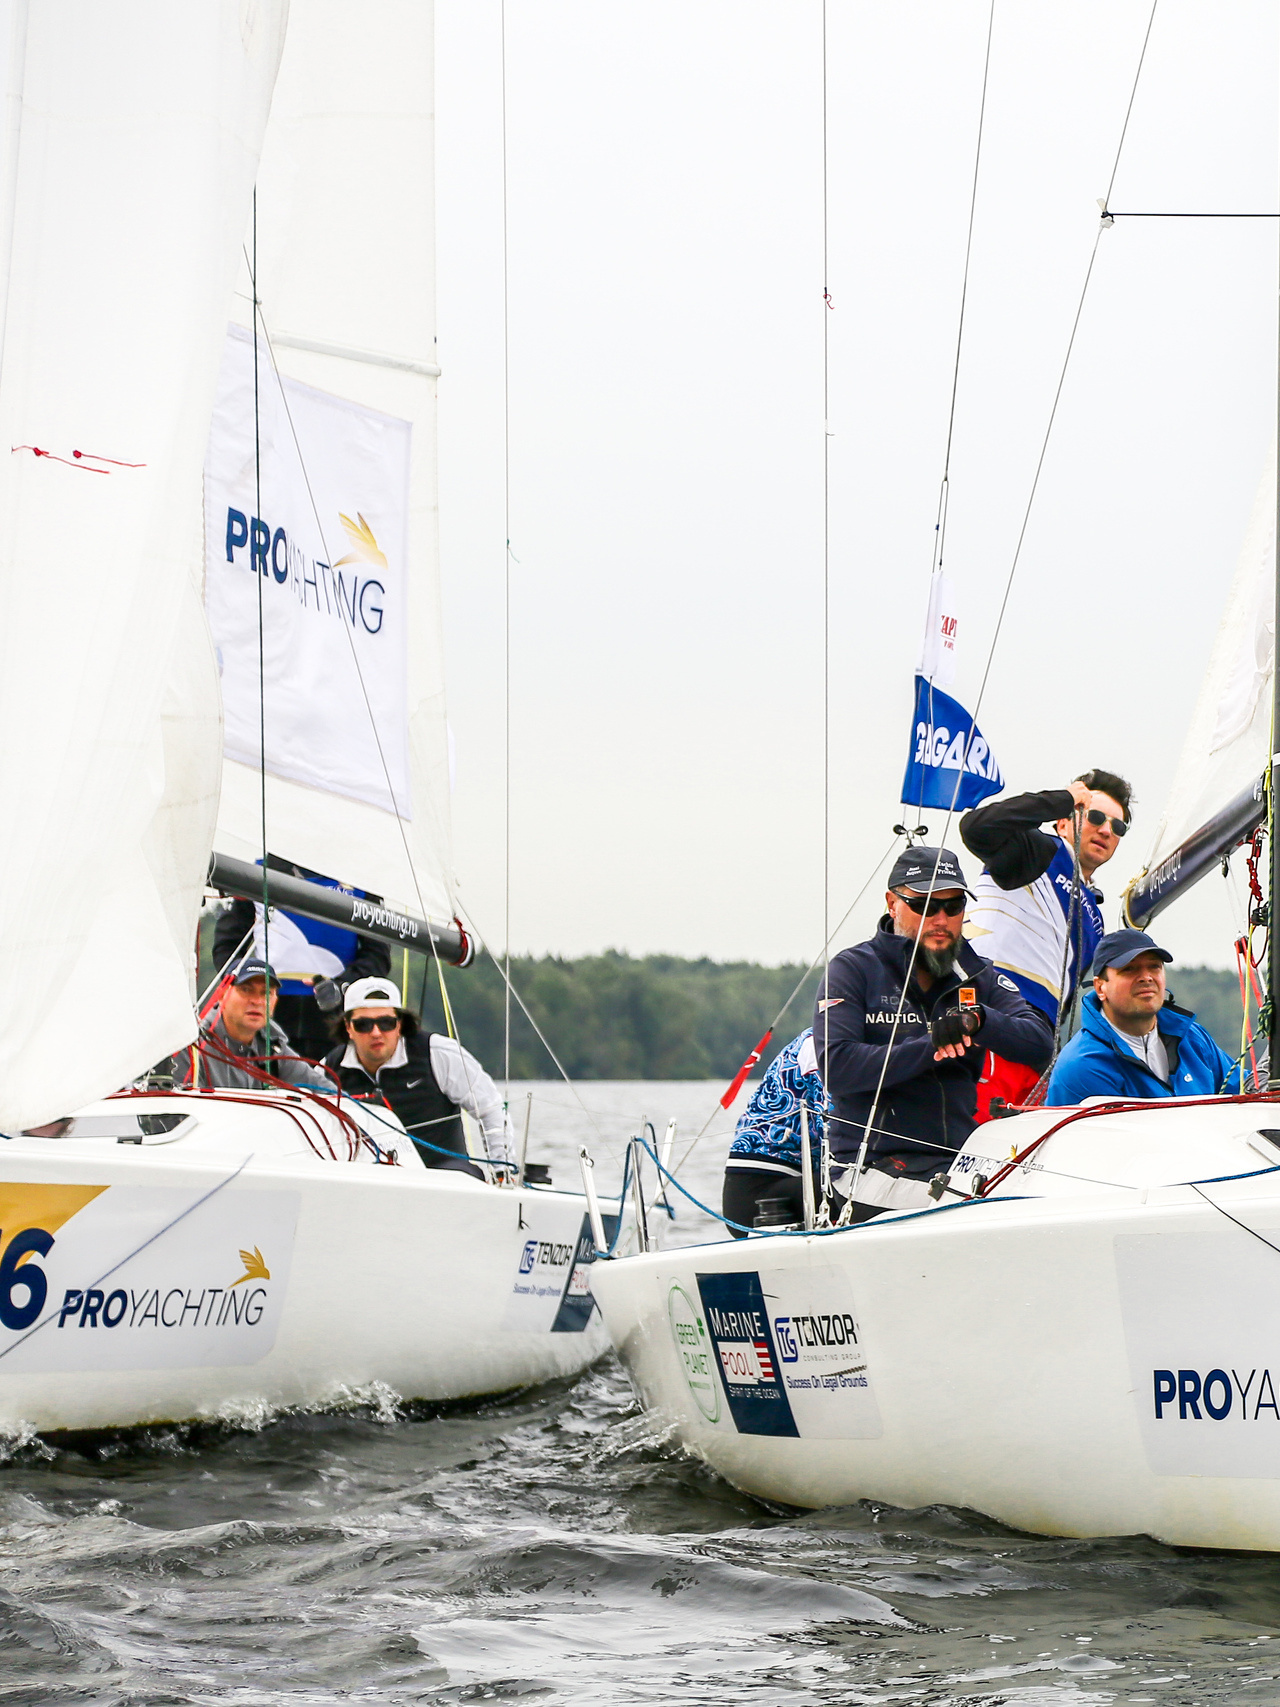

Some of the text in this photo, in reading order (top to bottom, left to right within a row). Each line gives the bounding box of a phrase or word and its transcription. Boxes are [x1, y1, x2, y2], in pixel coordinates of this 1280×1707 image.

[226, 506, 386, 634] PROYACHTING
[351, 900, 418, 939] pro-yachting.ru
[537, 1242, 573, 1266] TENZOR
[0, 1228, 55, 1330] 6
[58, 1288, 267, 1328] PROYACHTING
[708, 1307, 765, 1337] MARINE
[676, 1323, 700, 1345] GREEN
[792, 1314, 858, 1347] TENZOR
[683, 1351, 710, 1375] PLANET
[720, 1351, 754, 1376] POOL
[786, 1373, 868, 1392] Success On Legal Grounds
